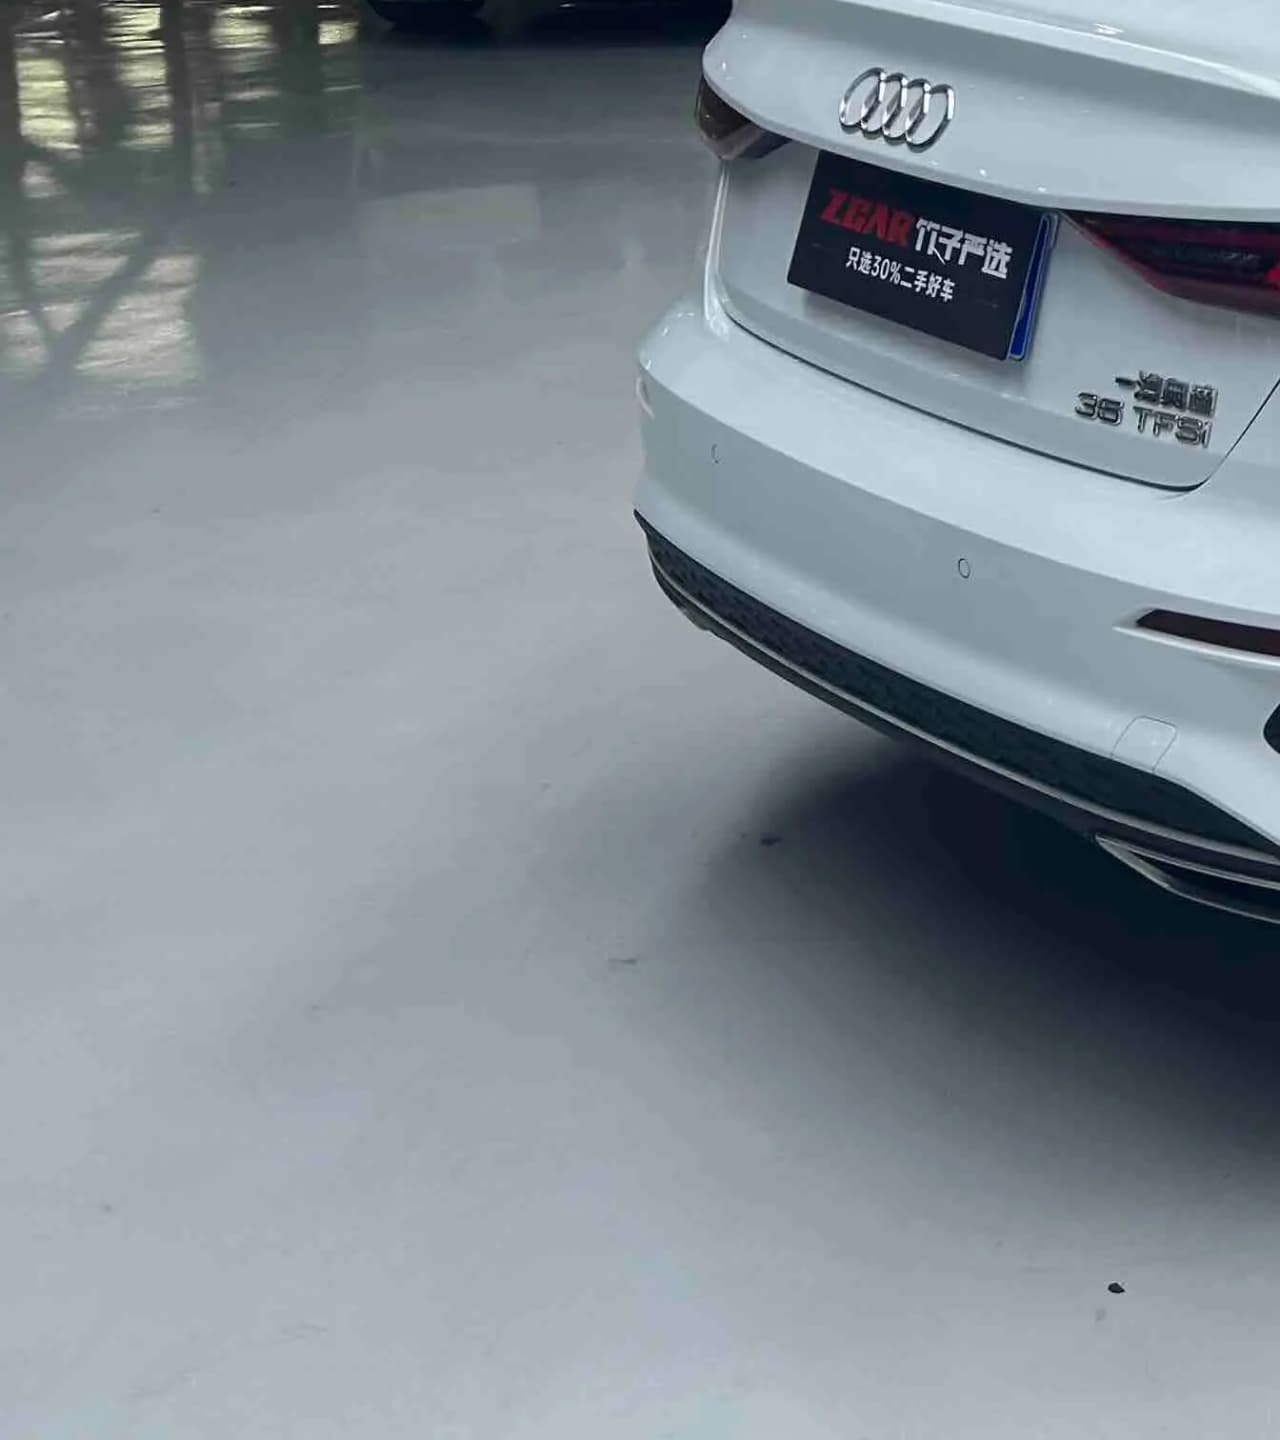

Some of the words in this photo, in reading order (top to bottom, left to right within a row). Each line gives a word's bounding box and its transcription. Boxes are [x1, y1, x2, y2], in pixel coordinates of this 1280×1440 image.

[820, 188, 916, 248] ZCAR
[914, 217, 1014, 279] 竹子严选
[845, 246, 956, 303] 只选30%二手好车
[1133, 405, 1212, 449] TFSI
